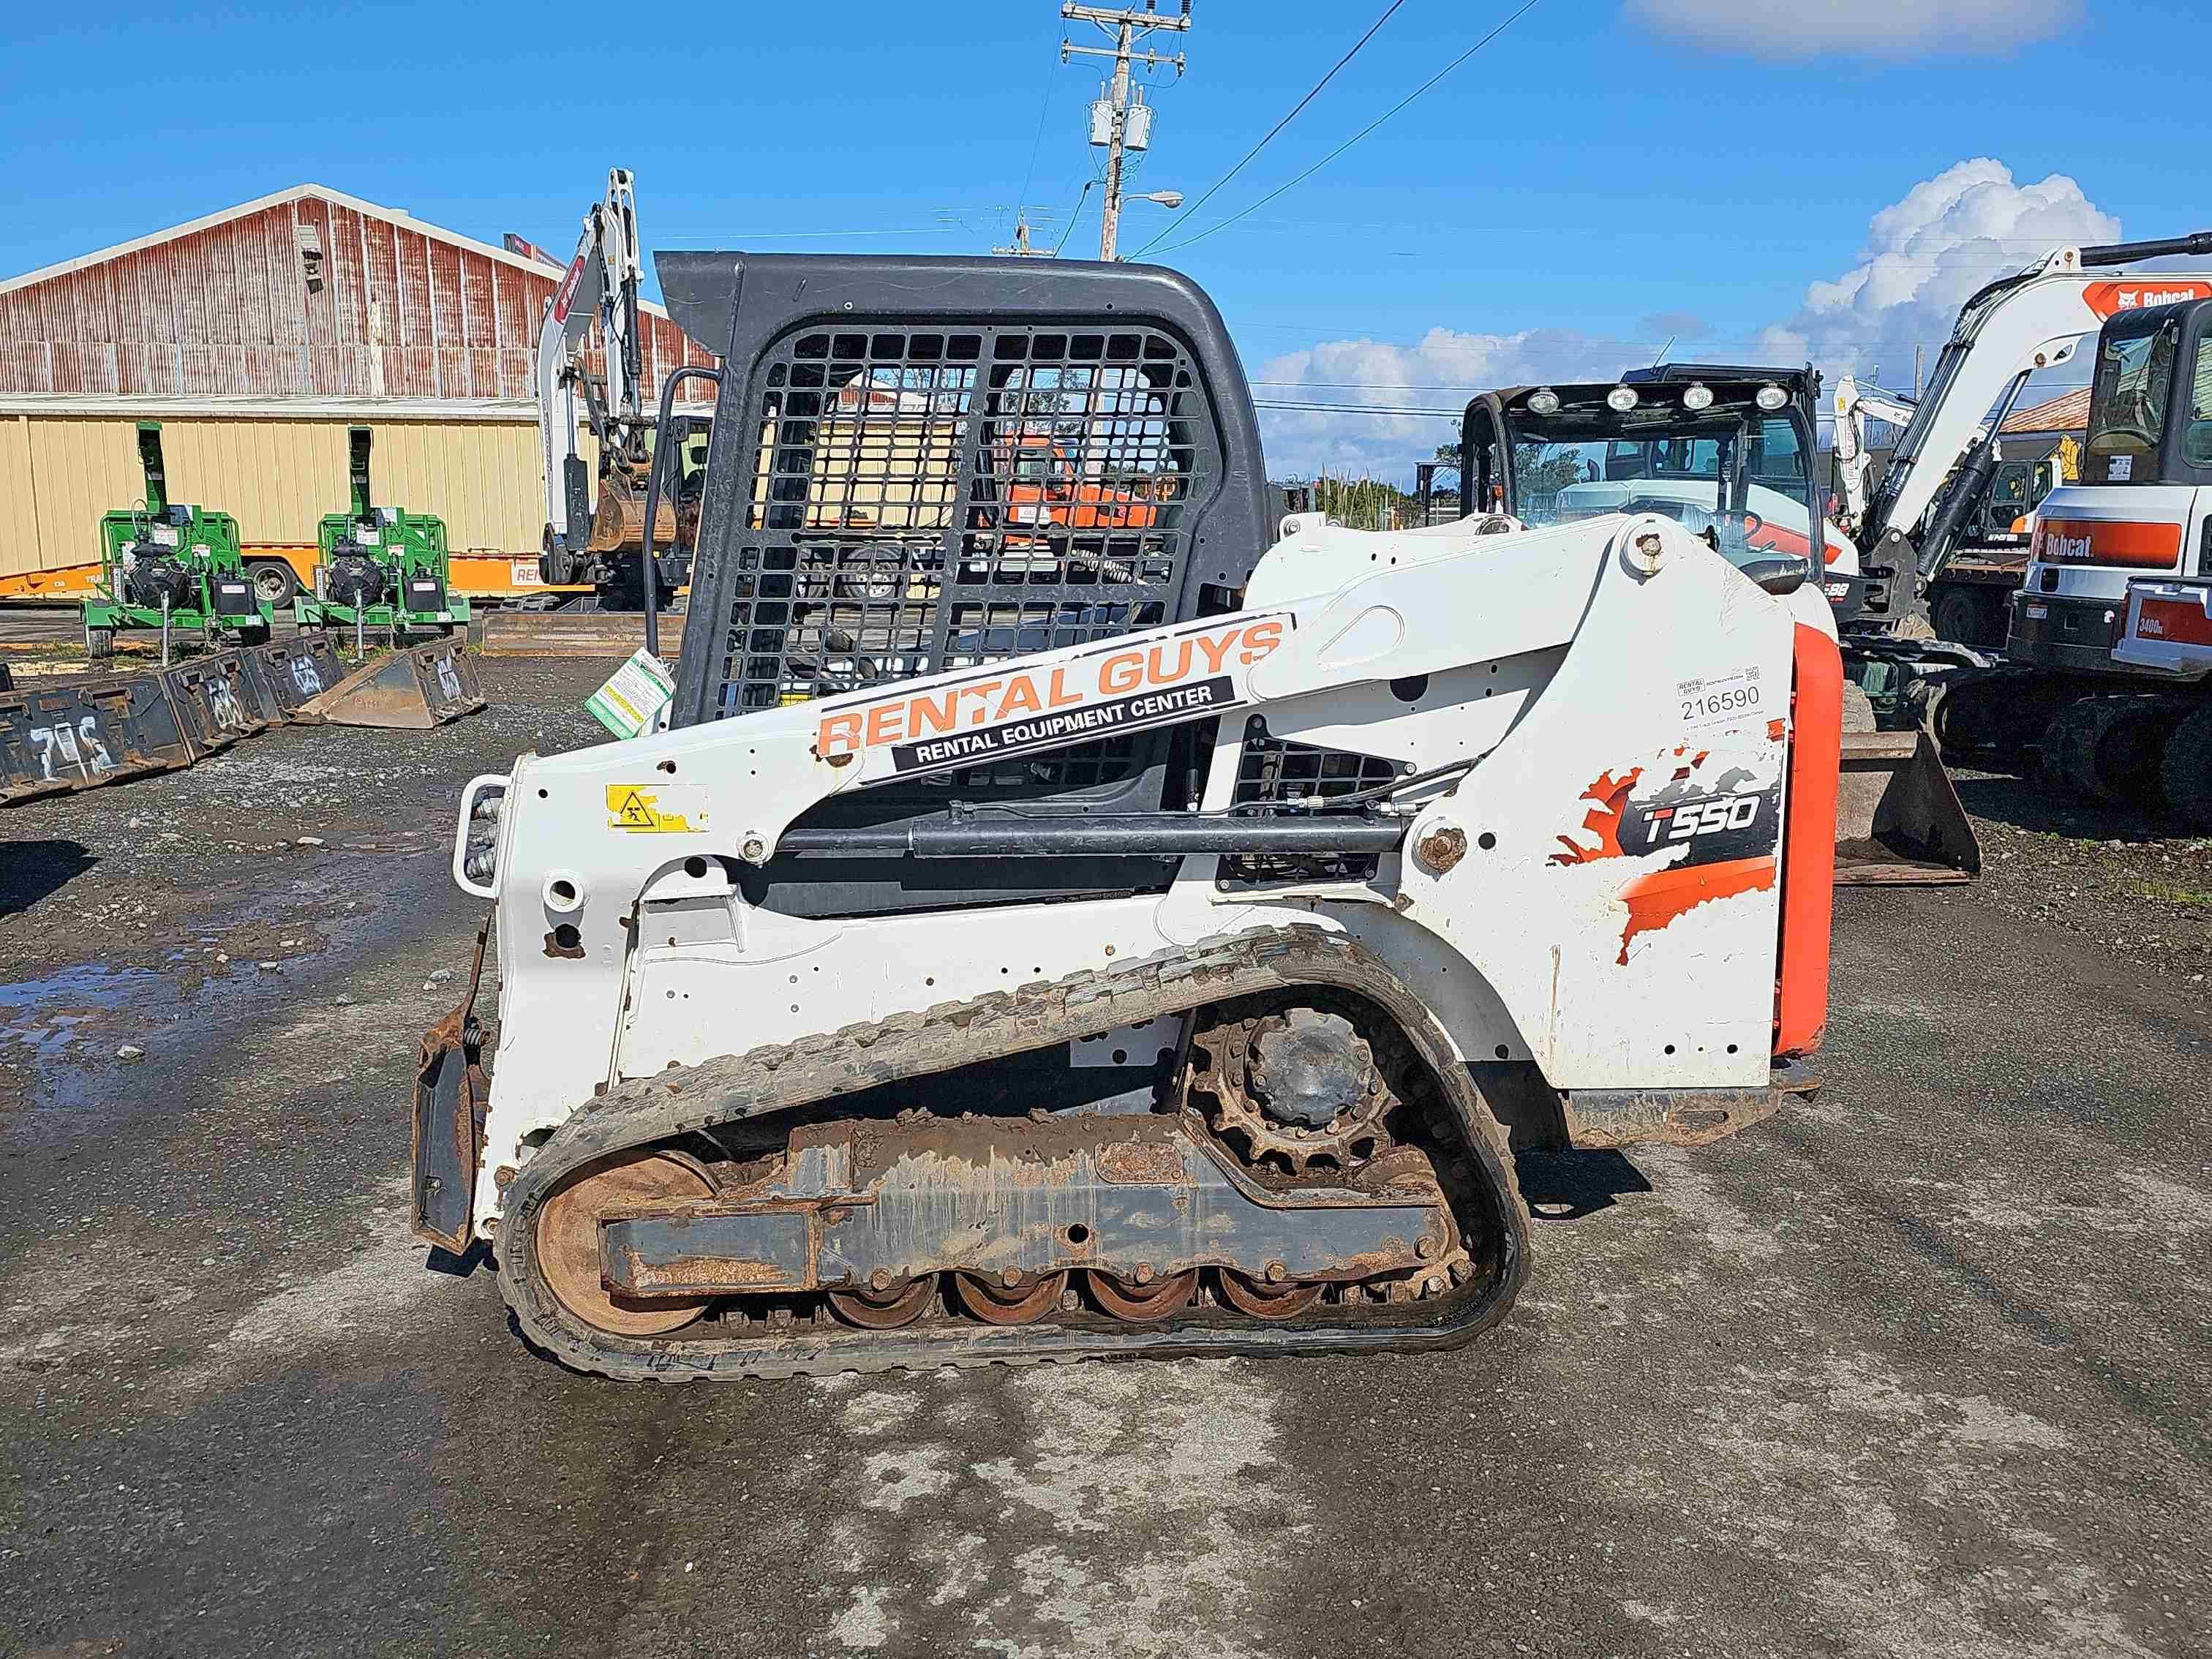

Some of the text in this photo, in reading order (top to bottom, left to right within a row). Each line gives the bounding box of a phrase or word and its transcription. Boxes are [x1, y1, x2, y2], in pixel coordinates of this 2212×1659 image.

[2045, 533, 2093, 558] Bobcat
[819, 621, 1284, 757] RENTAL GUYS
[1679, 680, 1704, 690] RENTAL
[1681, 685, 1759, 721] 216590
[915, 685, 1213, 764] RENTAL EQUIPMENT CENTER
[1643, 795, 1761, 843] T550
